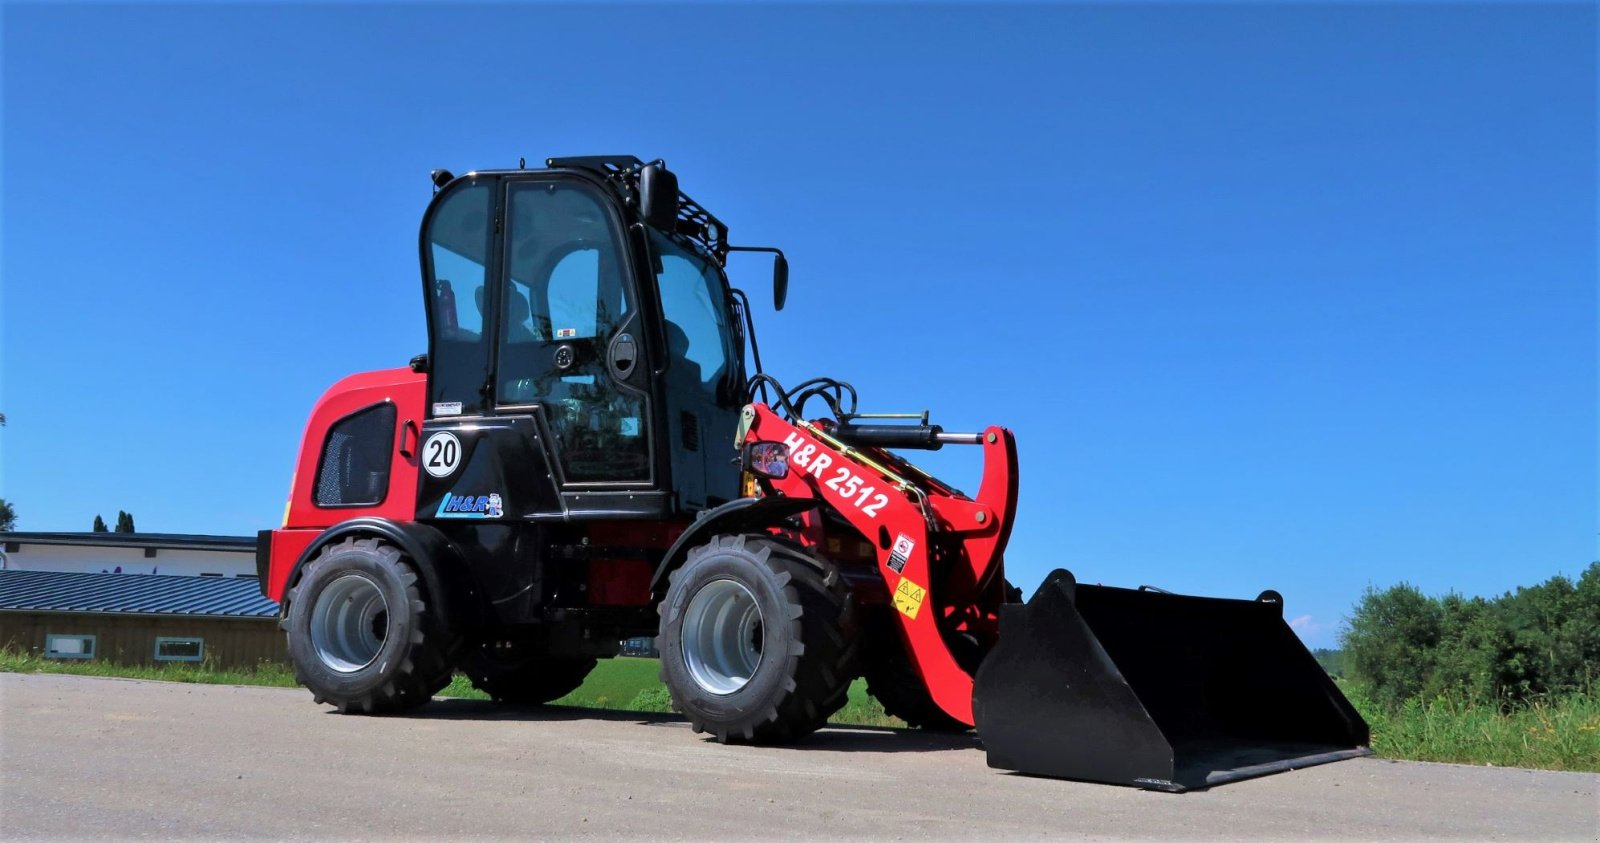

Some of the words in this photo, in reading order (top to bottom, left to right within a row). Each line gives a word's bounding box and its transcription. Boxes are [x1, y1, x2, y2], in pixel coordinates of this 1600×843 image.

[428, 439, 456, 468] 20
[783, 431, 833, 479] H&R
[824, 467, 889, 519] 2512
[445, 495, 489, 512] H&R
